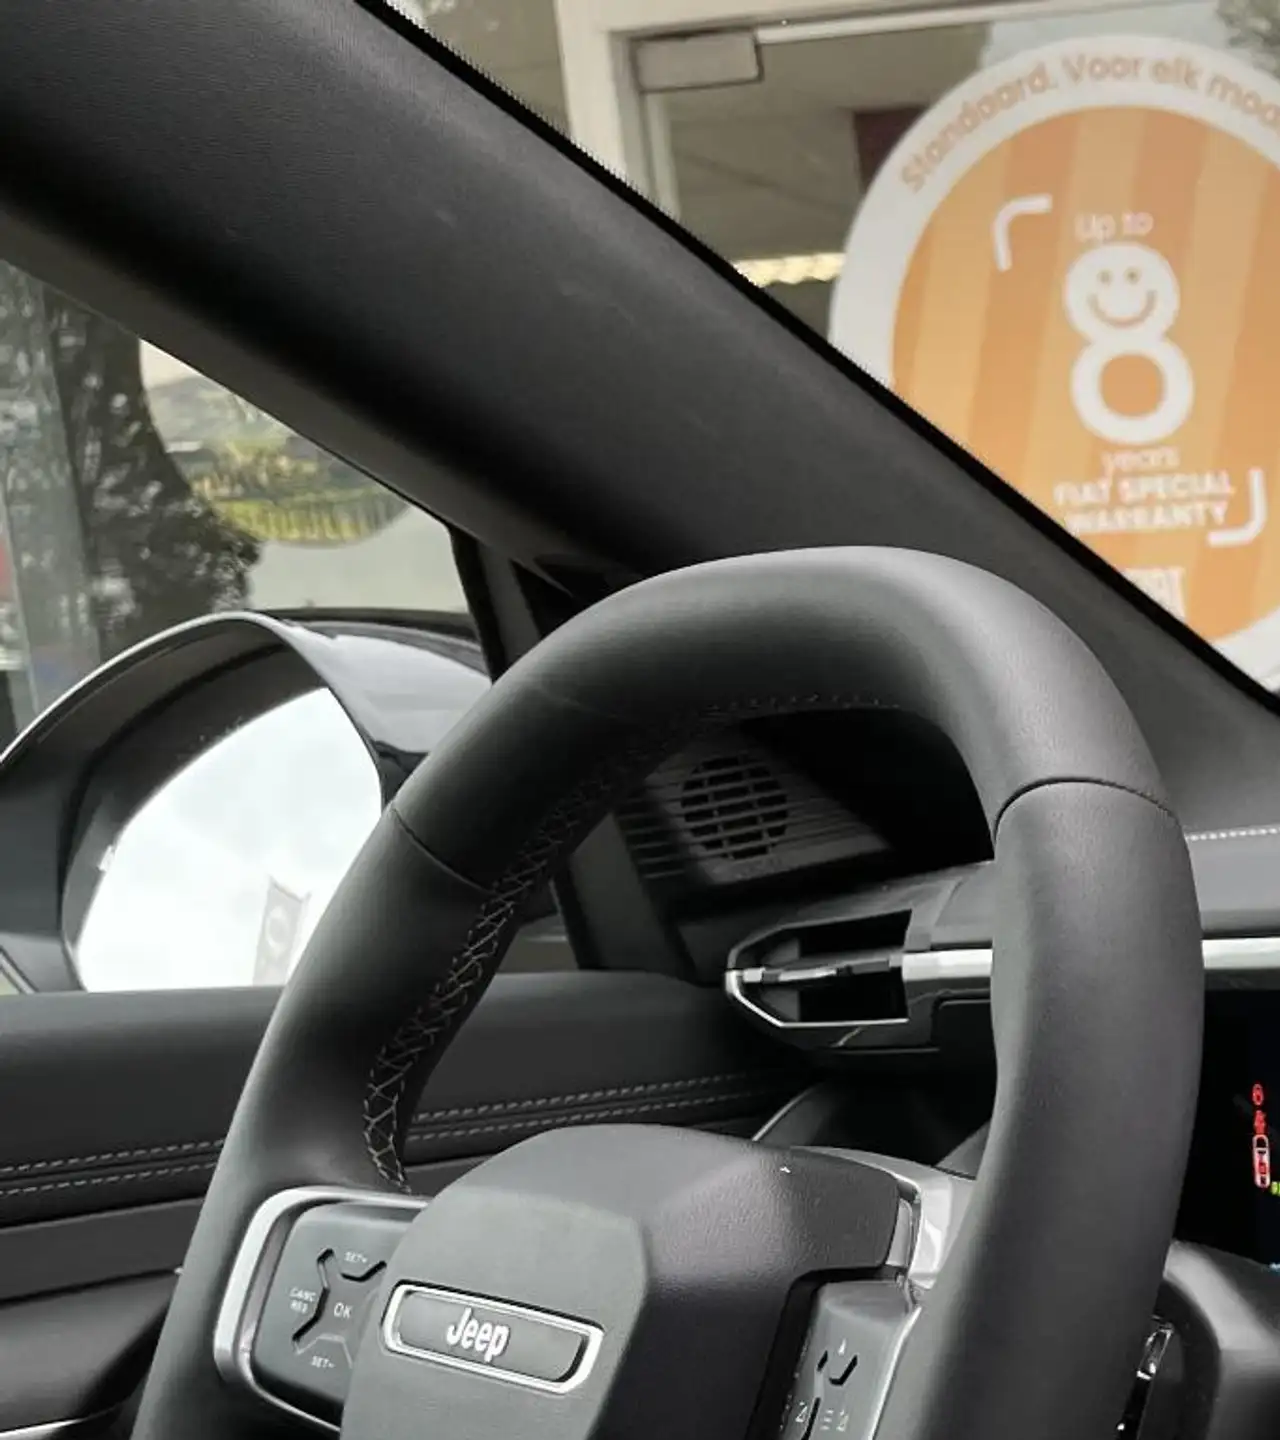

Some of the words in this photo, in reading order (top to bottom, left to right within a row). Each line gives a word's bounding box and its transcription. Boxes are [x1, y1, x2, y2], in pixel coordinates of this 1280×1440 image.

[1061, 53, 1144, 84] Voor
[1149, 57, 1201, 88] elk
[1075, 214, 1115, 243] Up
[1121, 211, 1153, 236] to
[1063, 240, 1195, 445] 8
[1102, 447, 1179, 480] years
[1117, 469, 1236, 503] SPECIAL
[333, 1301, 353, 1320] OK
[446, 1307, 511, 1363] Jeep
